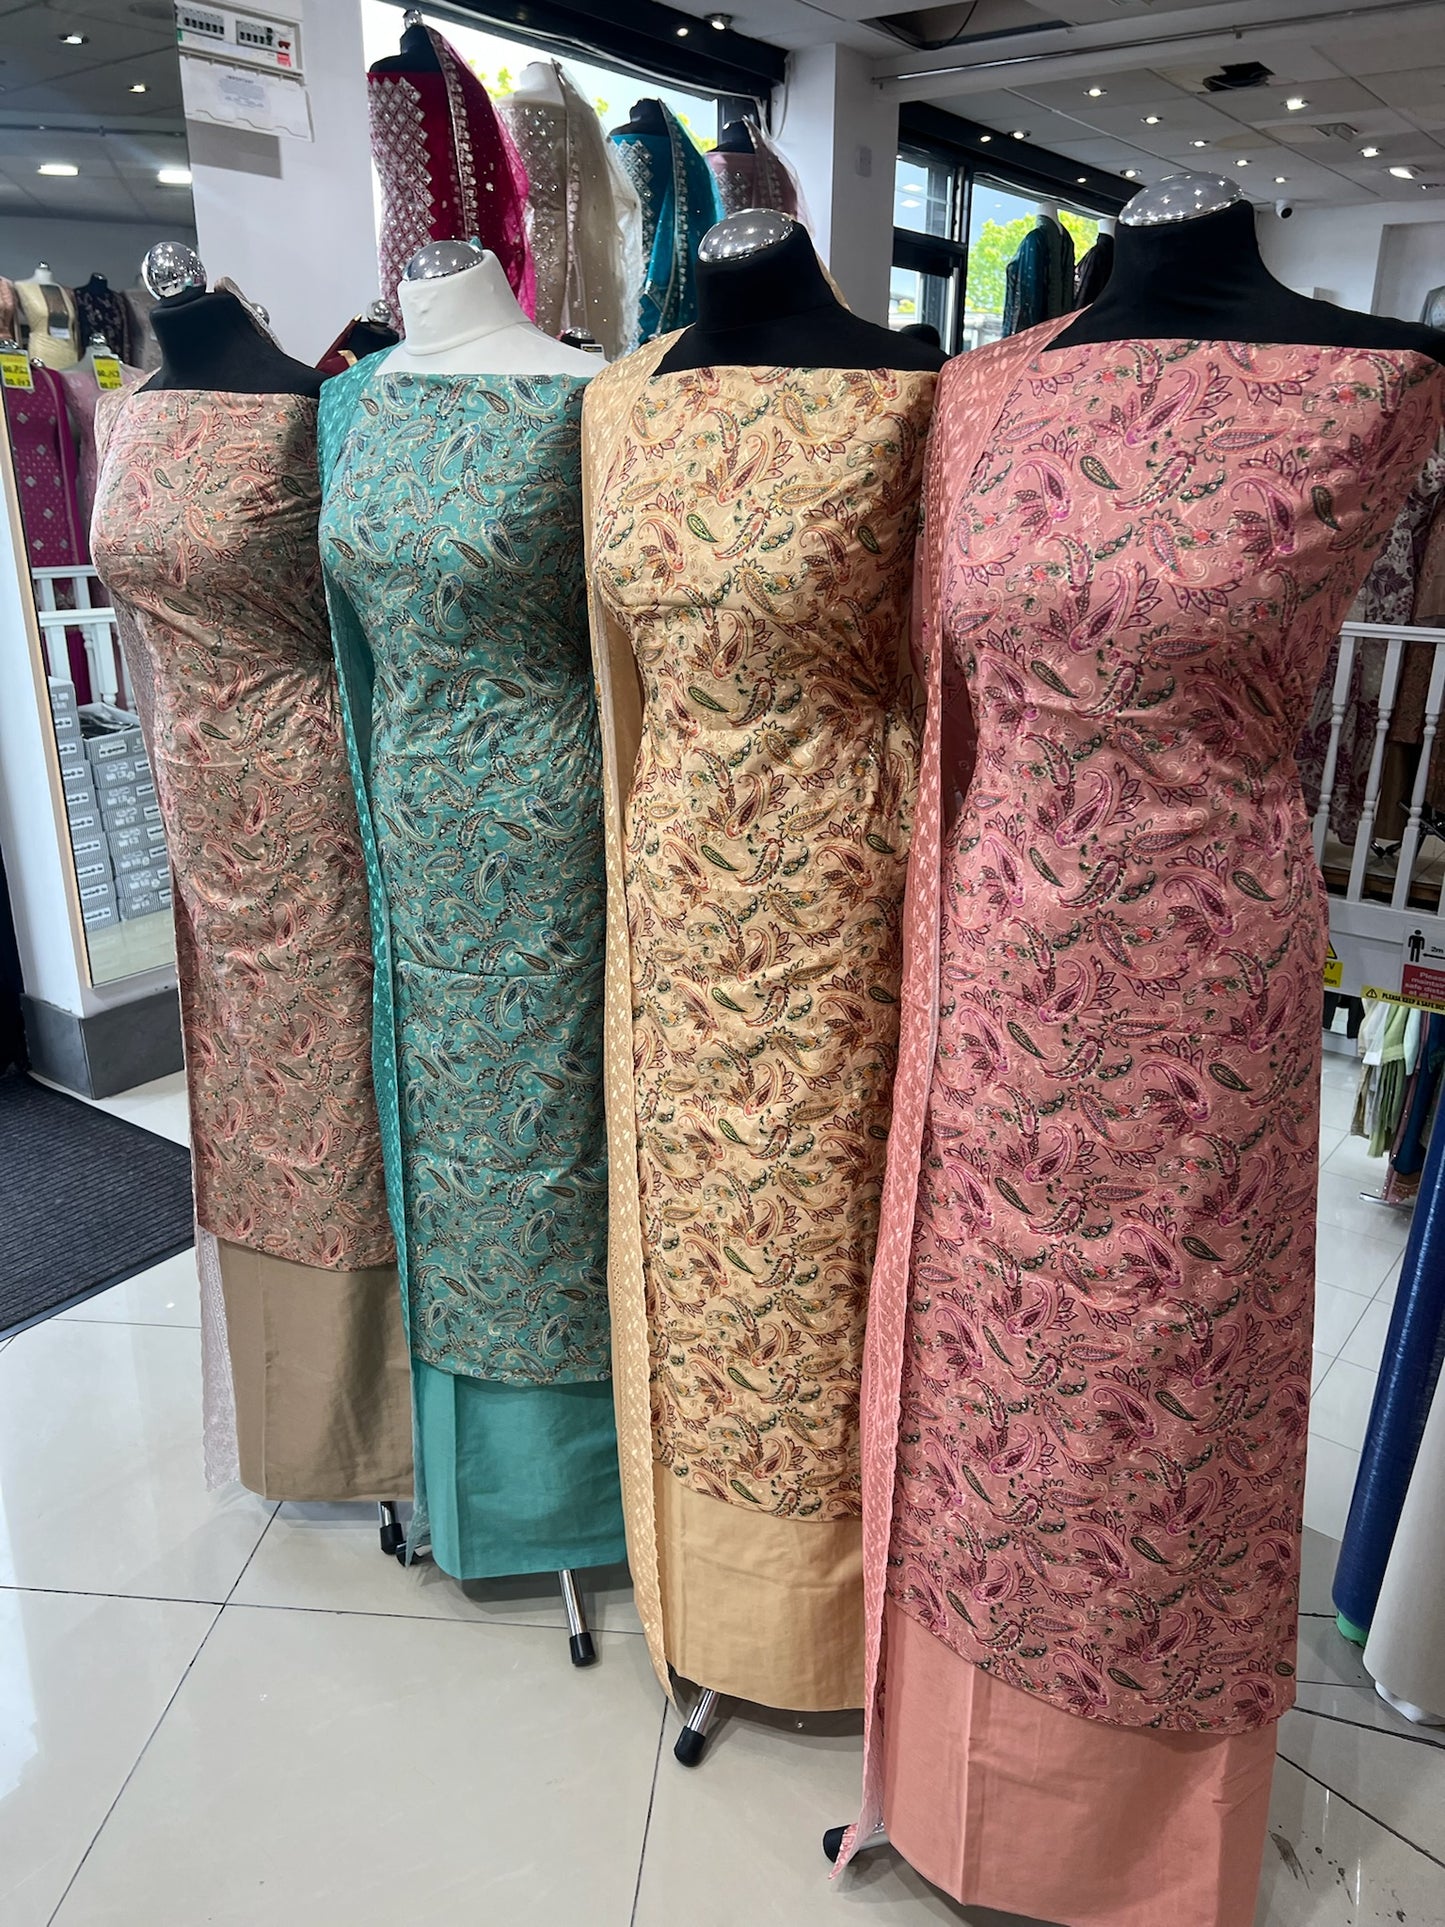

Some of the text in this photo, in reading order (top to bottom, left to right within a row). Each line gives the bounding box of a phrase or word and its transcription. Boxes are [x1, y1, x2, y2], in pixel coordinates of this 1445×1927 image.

[1424, 986, 1445, 995] dista
[1382, 992, 1401, 1002] PLEASE
[1401, 996, 1416, 1005] KEEP
